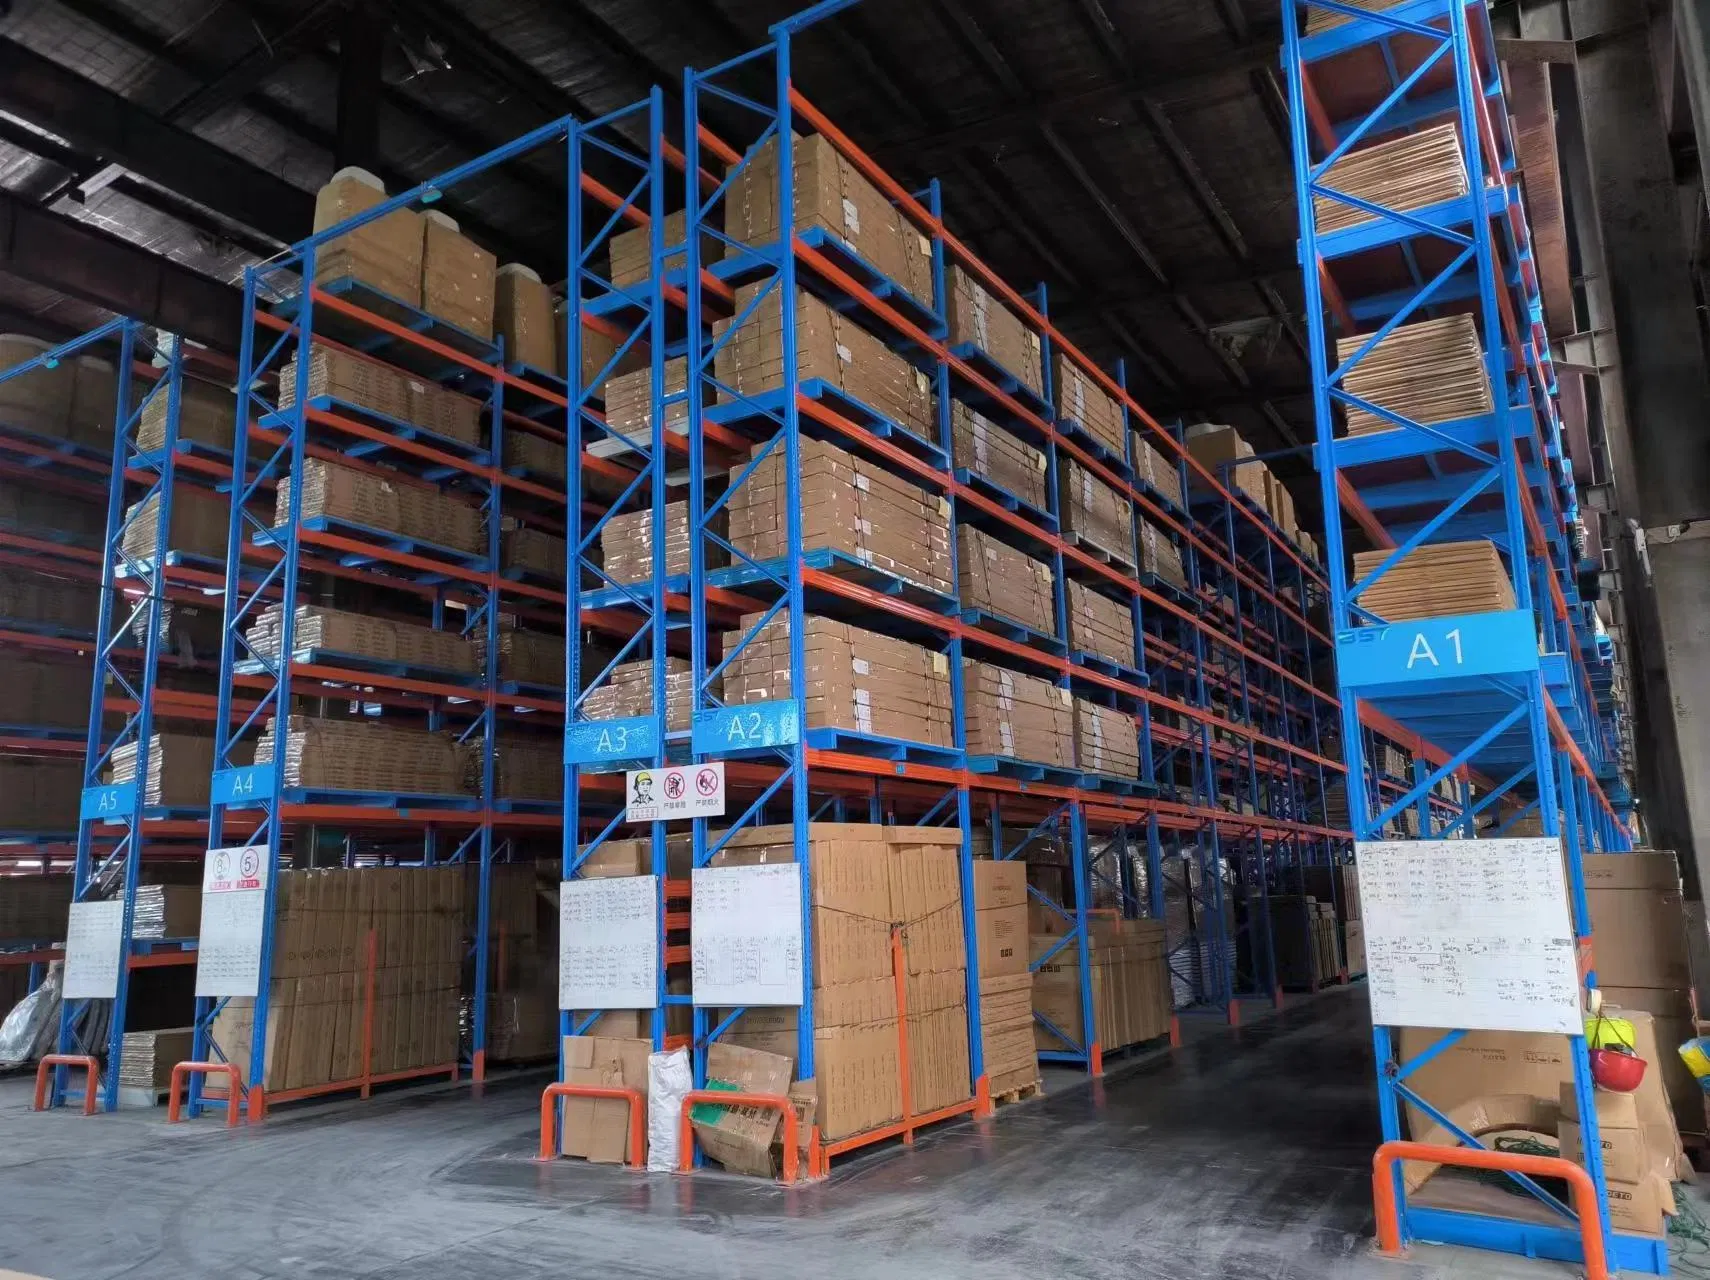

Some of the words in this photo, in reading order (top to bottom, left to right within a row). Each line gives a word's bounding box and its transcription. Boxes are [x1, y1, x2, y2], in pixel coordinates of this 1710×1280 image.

[1406, 628, 1464, 670] A1
[728, 712, 761, 741] A2
[596, 727, 627, 753] A3
[232, 774, 253, 794] A4
[98, 790, 118, 811] A5
